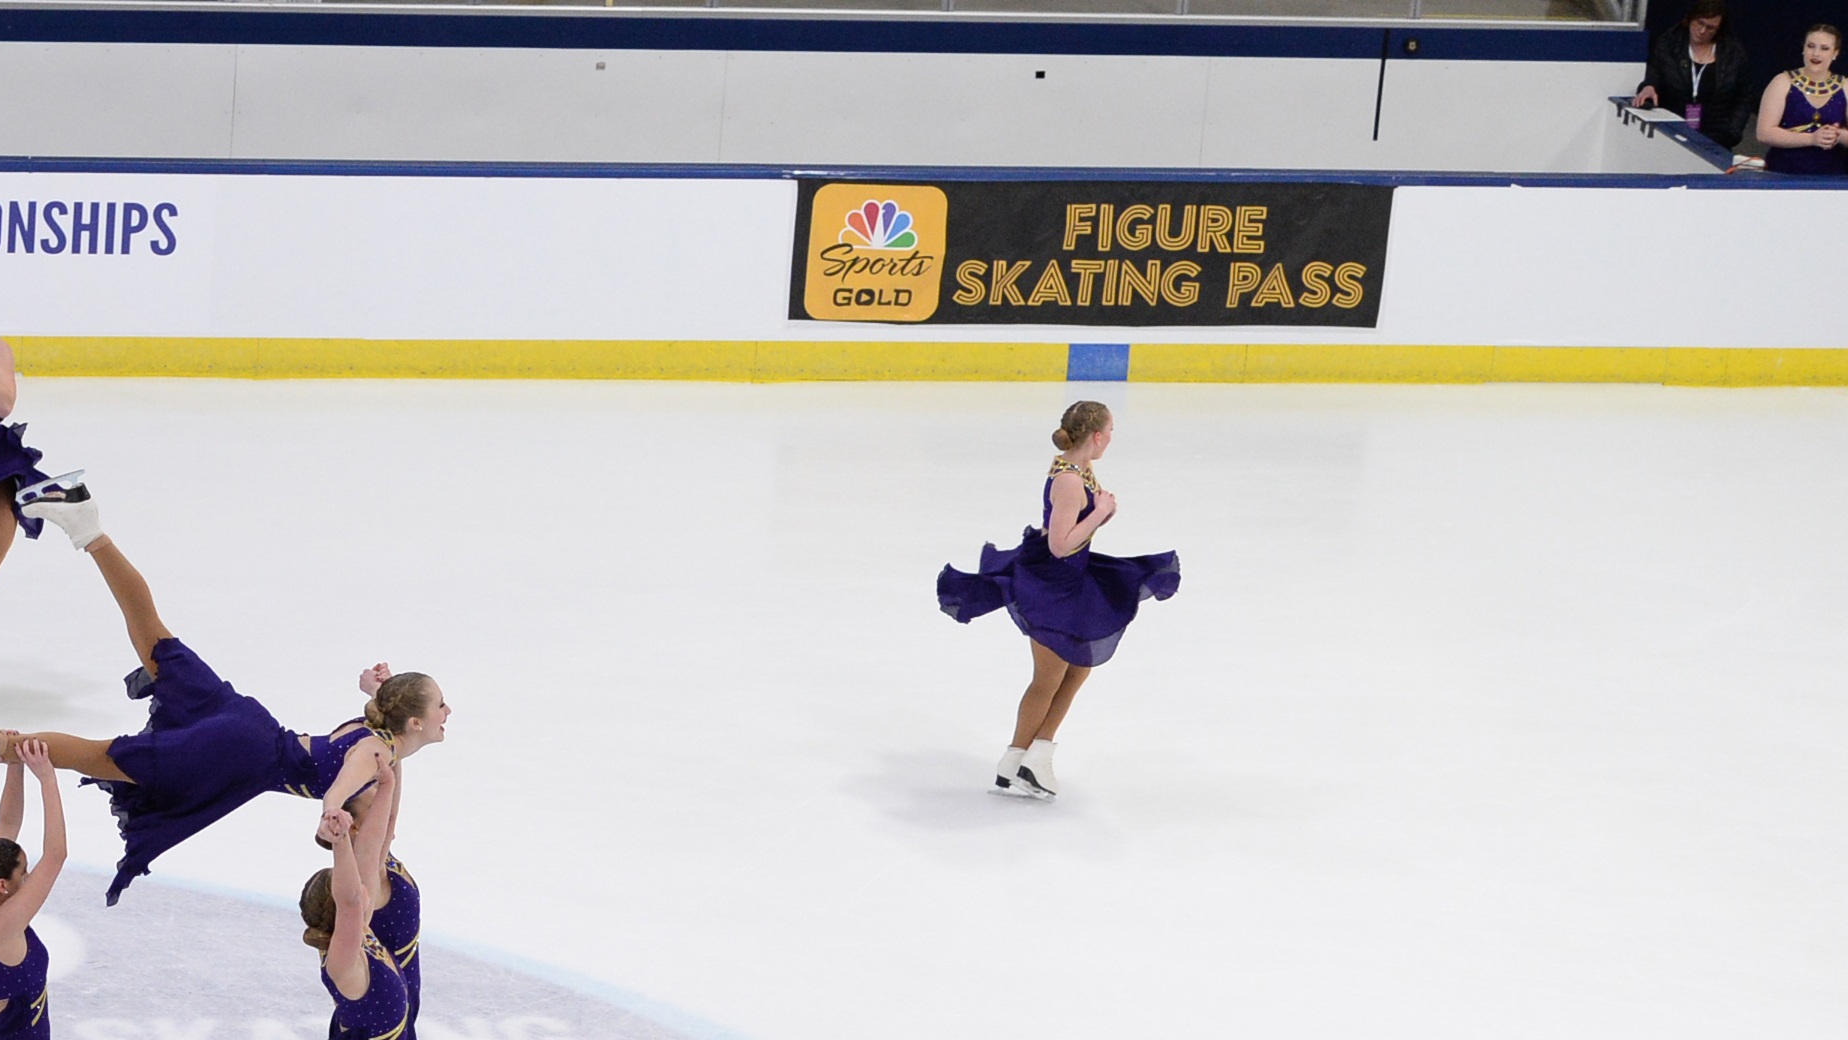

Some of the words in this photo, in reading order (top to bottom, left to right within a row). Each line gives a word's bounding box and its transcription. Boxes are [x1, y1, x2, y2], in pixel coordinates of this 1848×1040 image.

[1062, 203, 1268, 254] FIGURE
[820, 243, 934, 283] Sports
[953, 259, 1202, 307] SKATING
[1226, 261, 1367, 309] PASS
[833, 288, 912, 307] GOLD
